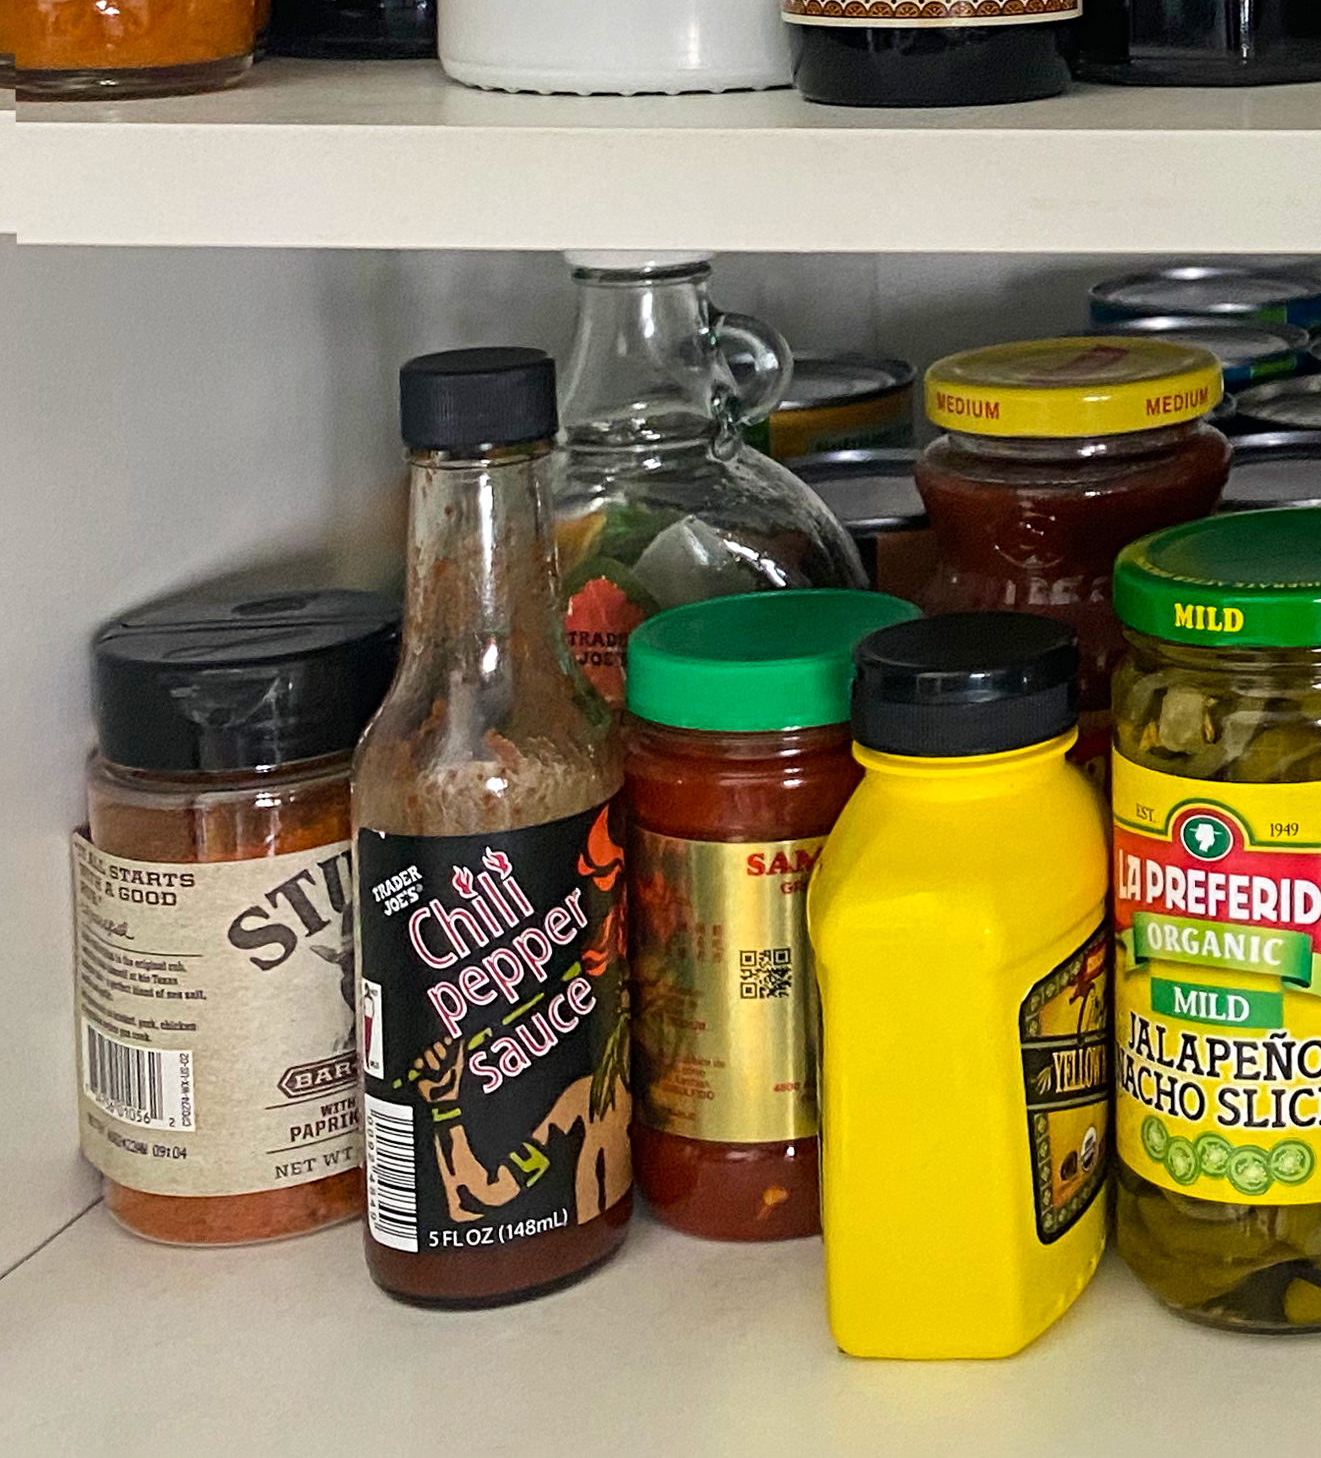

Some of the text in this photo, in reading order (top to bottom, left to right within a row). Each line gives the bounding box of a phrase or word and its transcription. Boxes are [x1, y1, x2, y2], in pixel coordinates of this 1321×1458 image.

[937, 392, 999, 419] MEDIUM
[1146, 387, 1208, 415] MEDIUM
[1174, 603, 1244, 633] MILD
[1269, 822, 1299, 838] 1949
[109, 865, 195, 887] STARTS
[1118, 849, 1141, 902] LA
[407, 847, 535, 970] Chili
[1146, 922, 1283, 965] ORGANIC
[425, 888, 589, 1038] pepper
[1173, 987, 1250, 1022] MILD
[467, 973, 598, 1093] sauce
